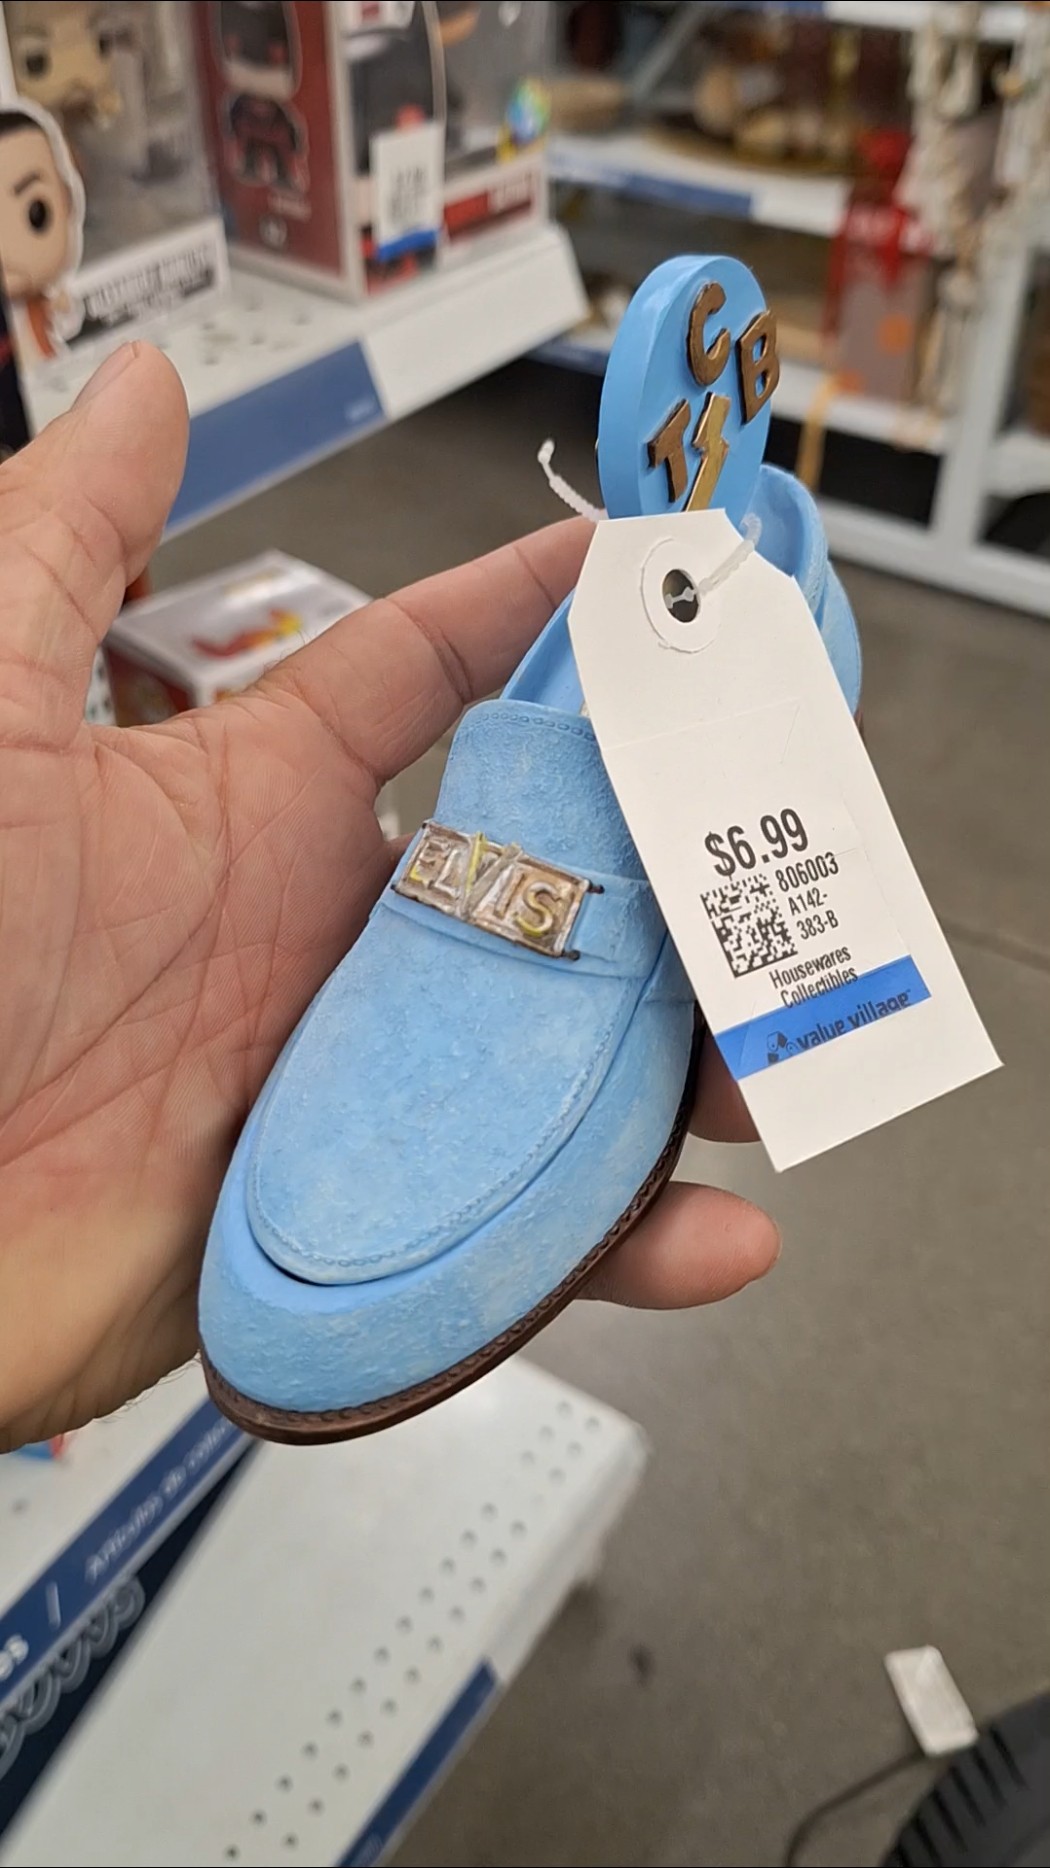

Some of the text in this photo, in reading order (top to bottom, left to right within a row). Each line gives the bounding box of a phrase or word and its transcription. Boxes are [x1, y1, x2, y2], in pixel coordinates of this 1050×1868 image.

[704, 808, 808, 881] $6.99
[408, 831, 561, 937] ELVIS
[775, 852, 839, 892] 806003
[788, 887, 828, 916] A142-
[796, 909, 839, 940] 383-B
[769, 946, 852, 989] Housewares
[780, 966, 859, 1009] Collectibles
[797, 991, 911, 1050] value village
